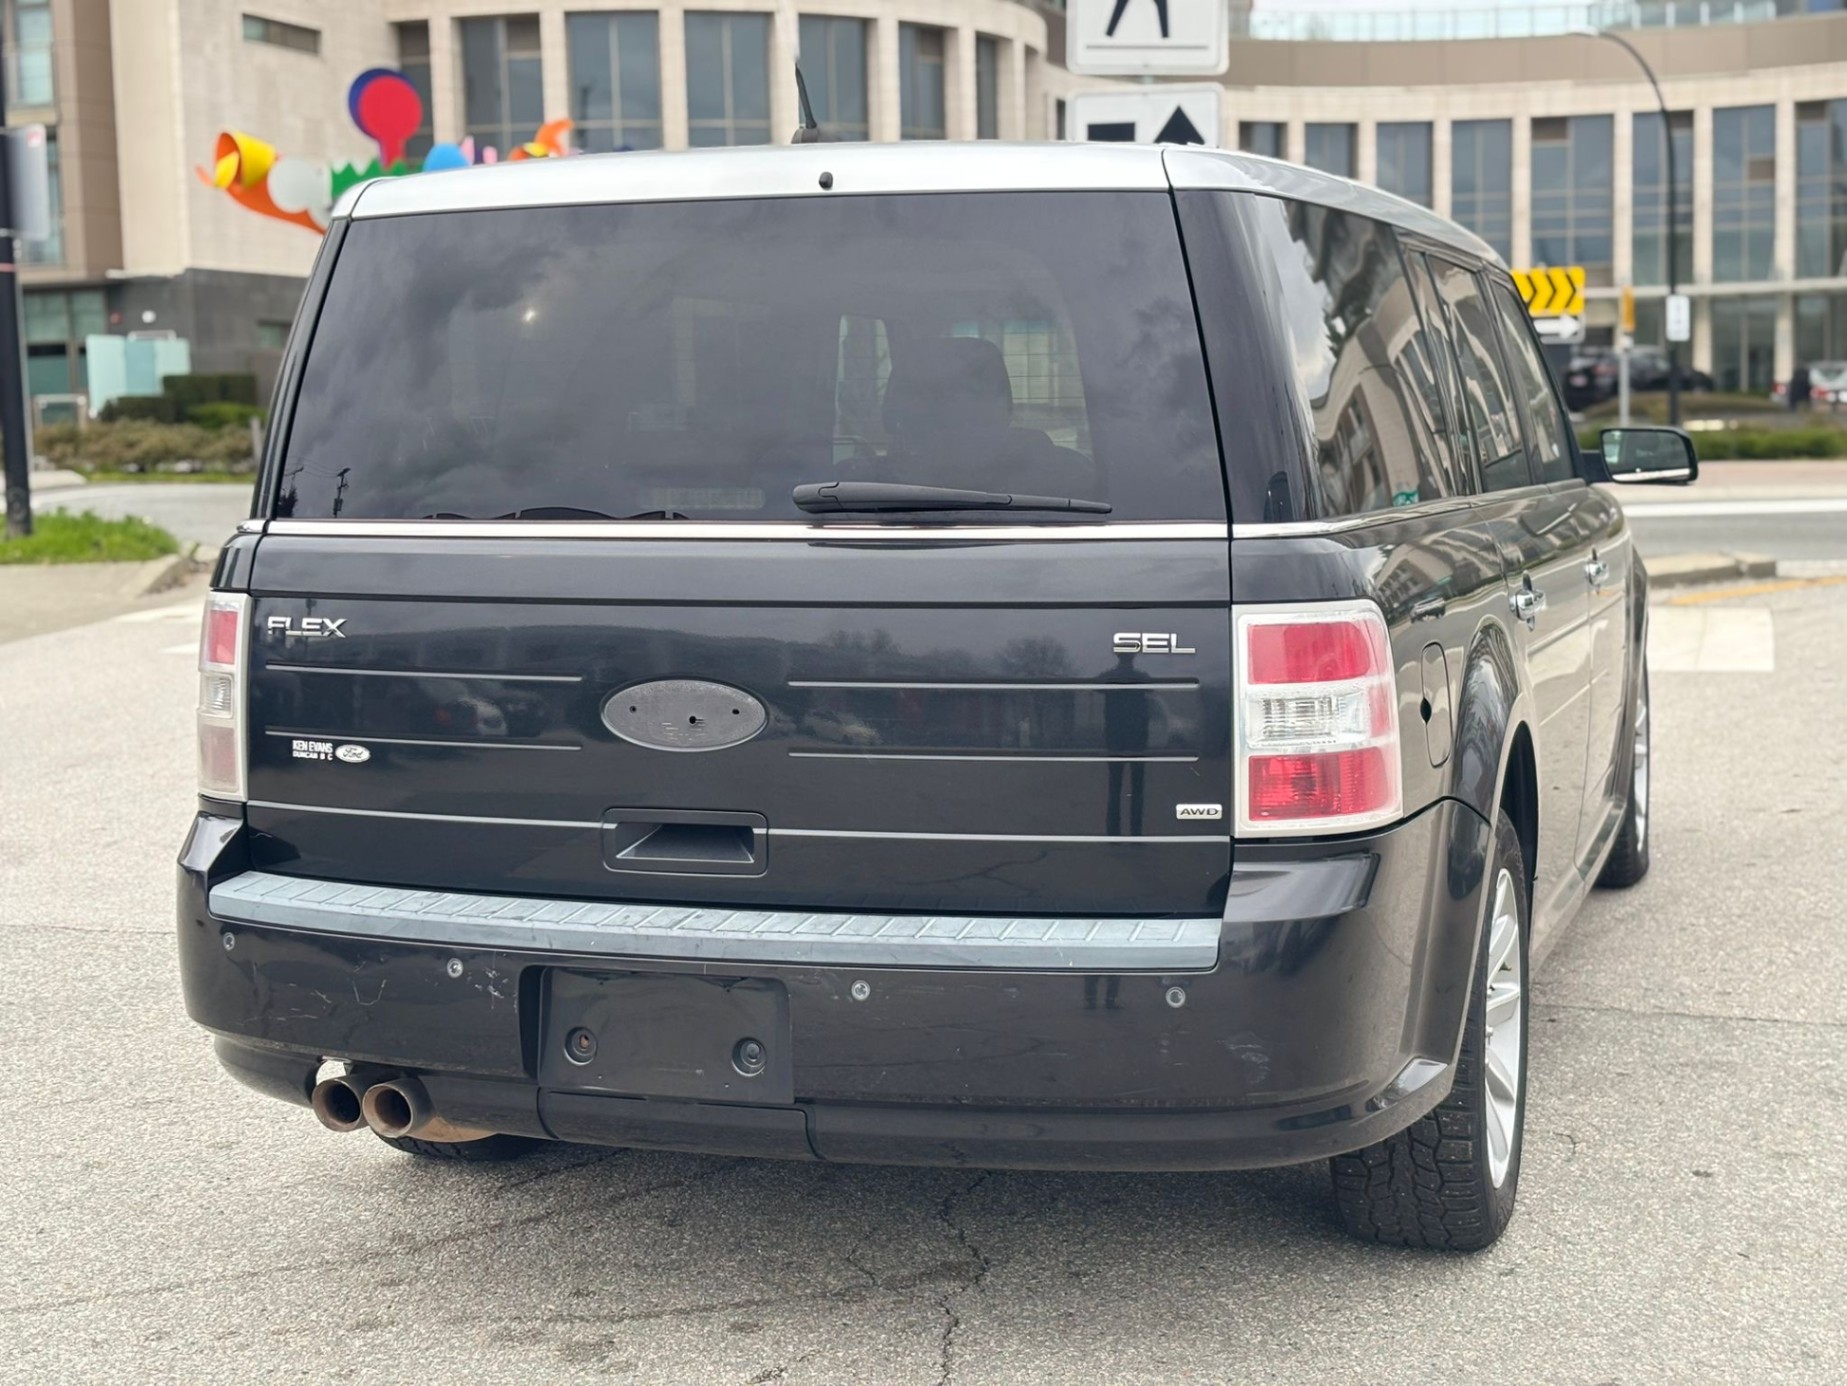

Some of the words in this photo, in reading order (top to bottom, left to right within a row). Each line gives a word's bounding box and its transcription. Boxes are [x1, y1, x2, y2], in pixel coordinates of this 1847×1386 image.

[267, 616, 347, 638] FLEX
[1113, 632, 1196, 654] SEL
[292, 740, 308, 751] KEN
[308, 741, 333, 753] EVANS
[1179, 807, 1219, 816] AWD
